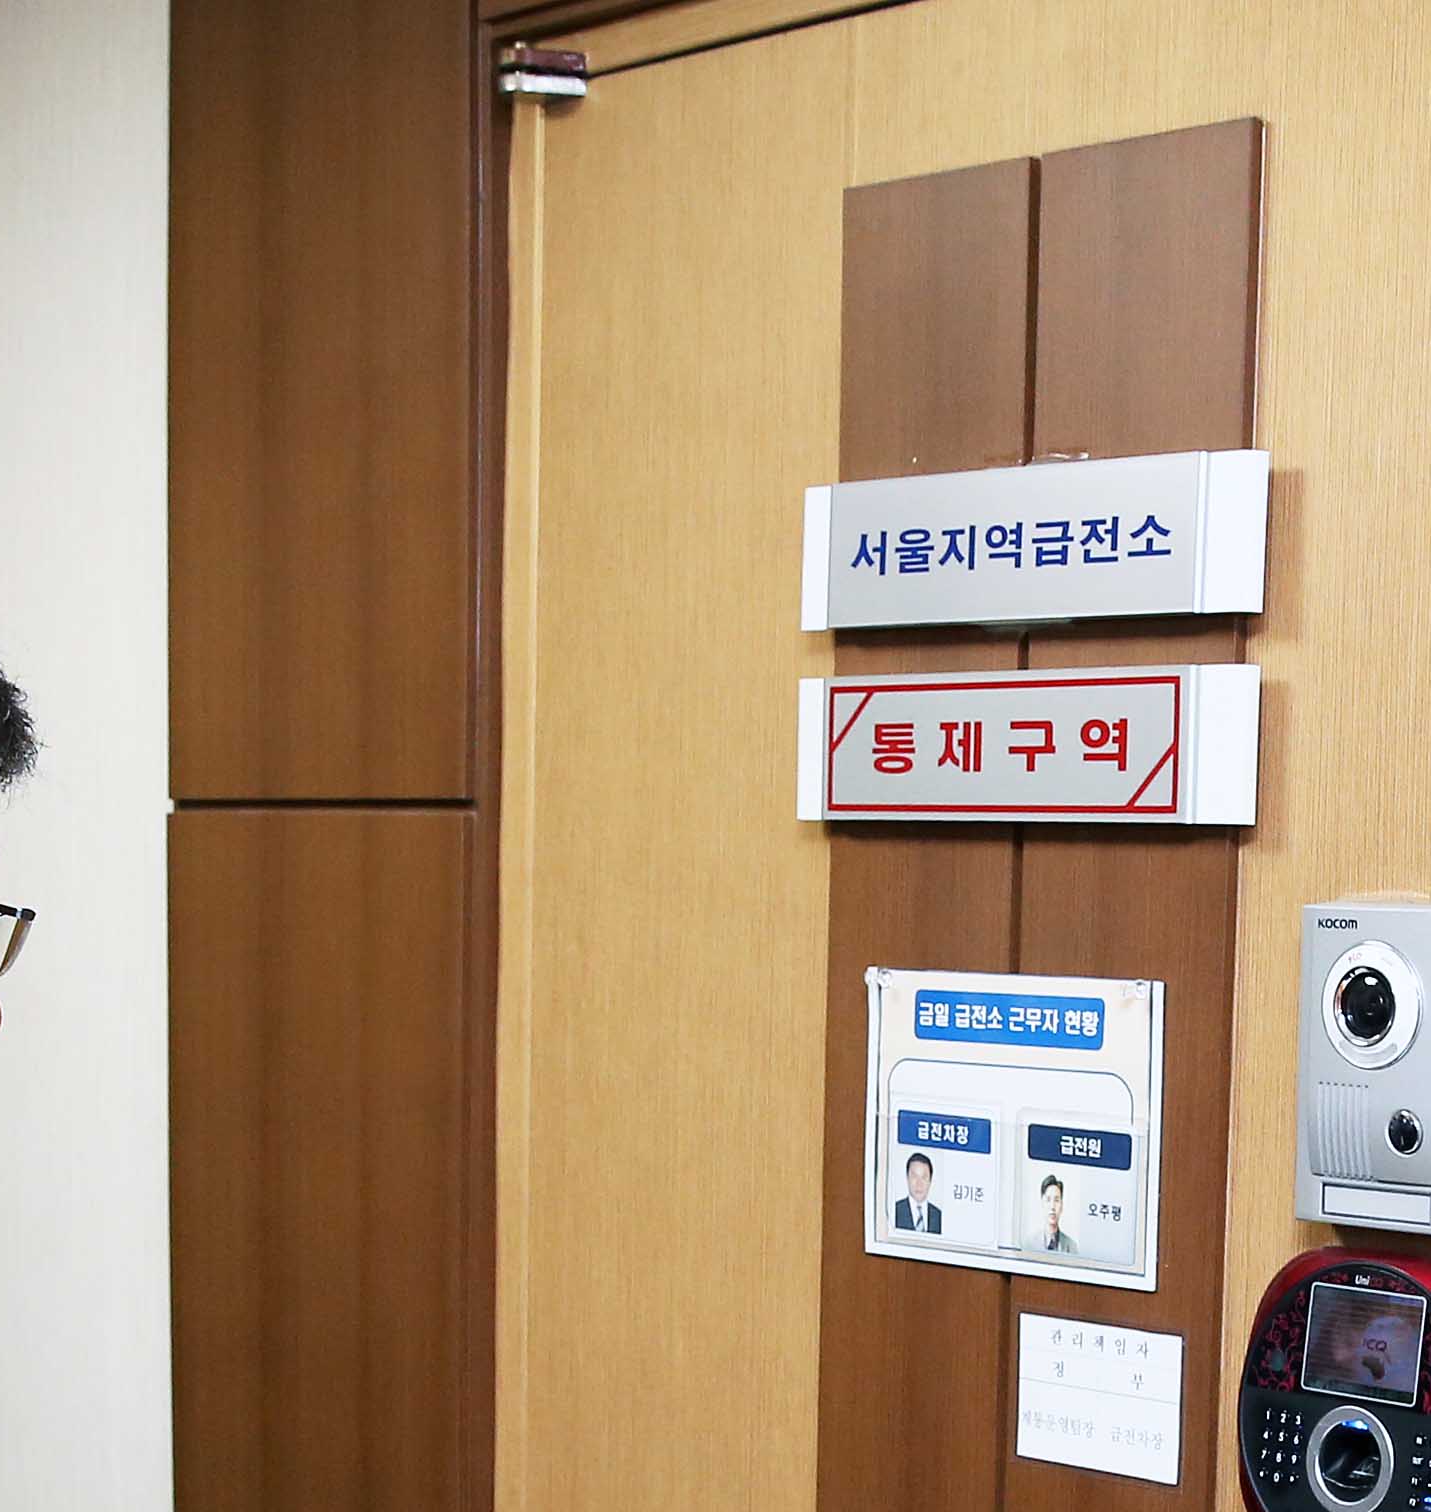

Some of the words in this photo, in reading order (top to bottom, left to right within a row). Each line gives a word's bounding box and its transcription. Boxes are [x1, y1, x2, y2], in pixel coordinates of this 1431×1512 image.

[851, 515, 1172, 576] 서울지역급전소
[1317, 917, 1358, 930] KOCOM
[919, 1002, 950, 1027] 금일
[955, 1004, 1003, 1029] 급전소
[1009, 1006, 1060, 1034] 근무자
[1064, 1010, 1100, 1037] 현황
[1059, 1134, 1103, 1159] 급전원
